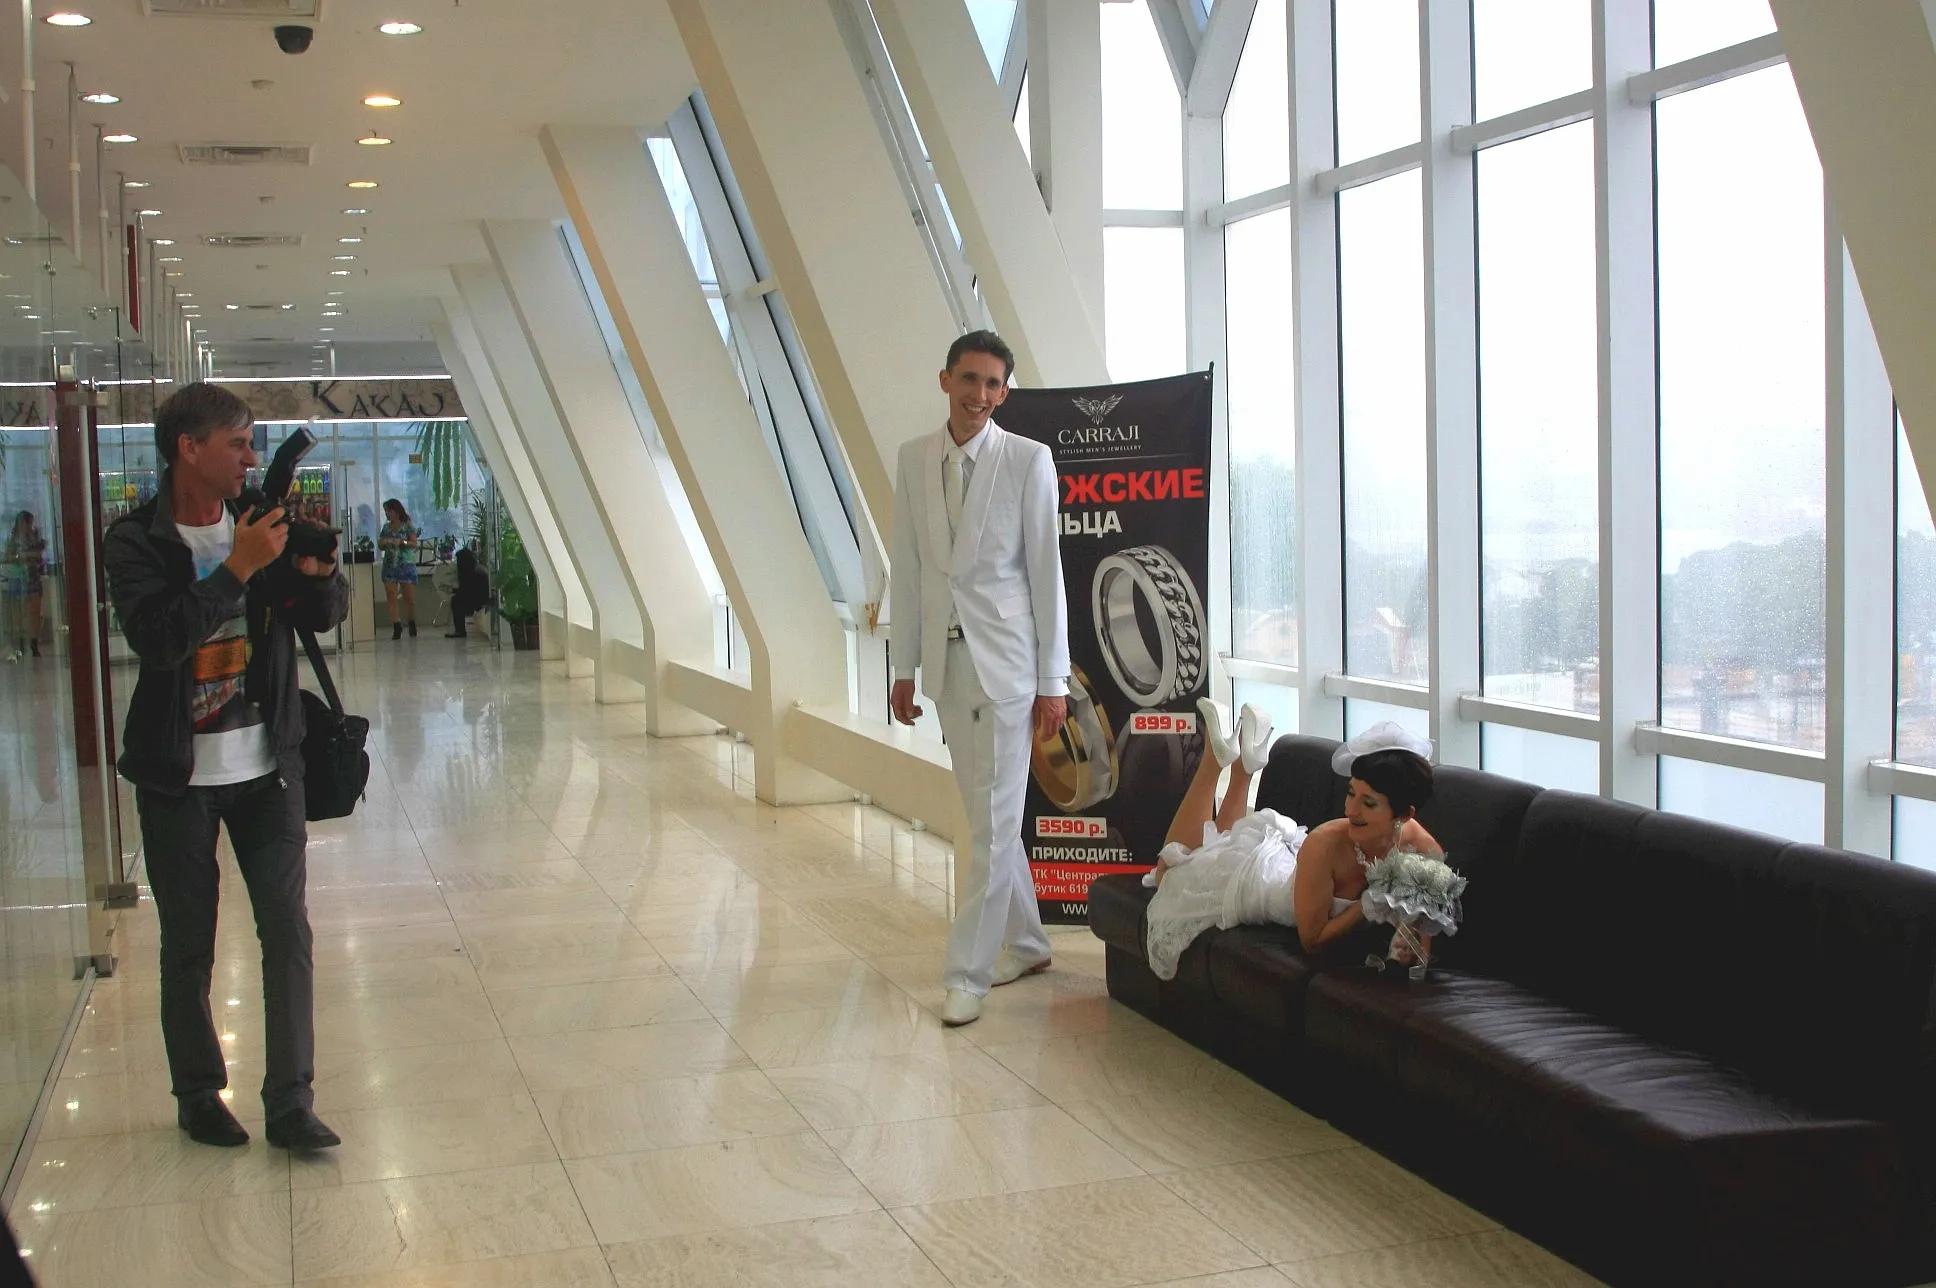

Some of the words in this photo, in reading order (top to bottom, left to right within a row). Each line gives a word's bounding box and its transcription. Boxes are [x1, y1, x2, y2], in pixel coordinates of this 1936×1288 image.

[1057, 425, 1139, 444] CARRAJI
[1107, 444, 1142, 452] JEWELLERY
[1057, 468, 1205, 504] ЖСКИЕ
[1134, 716, 1172, 730] 899
[1175, 718, 1192, 733] р.
[1039, 819, 1085, 834] 3590
[1088, 822, 1105, 837] р.
[1032, 846, 1133, 863] ПРИХОДИТЕ:
[1034, 868, 1048, 879] ТК
[1069, 883, 1088, 894] 619
